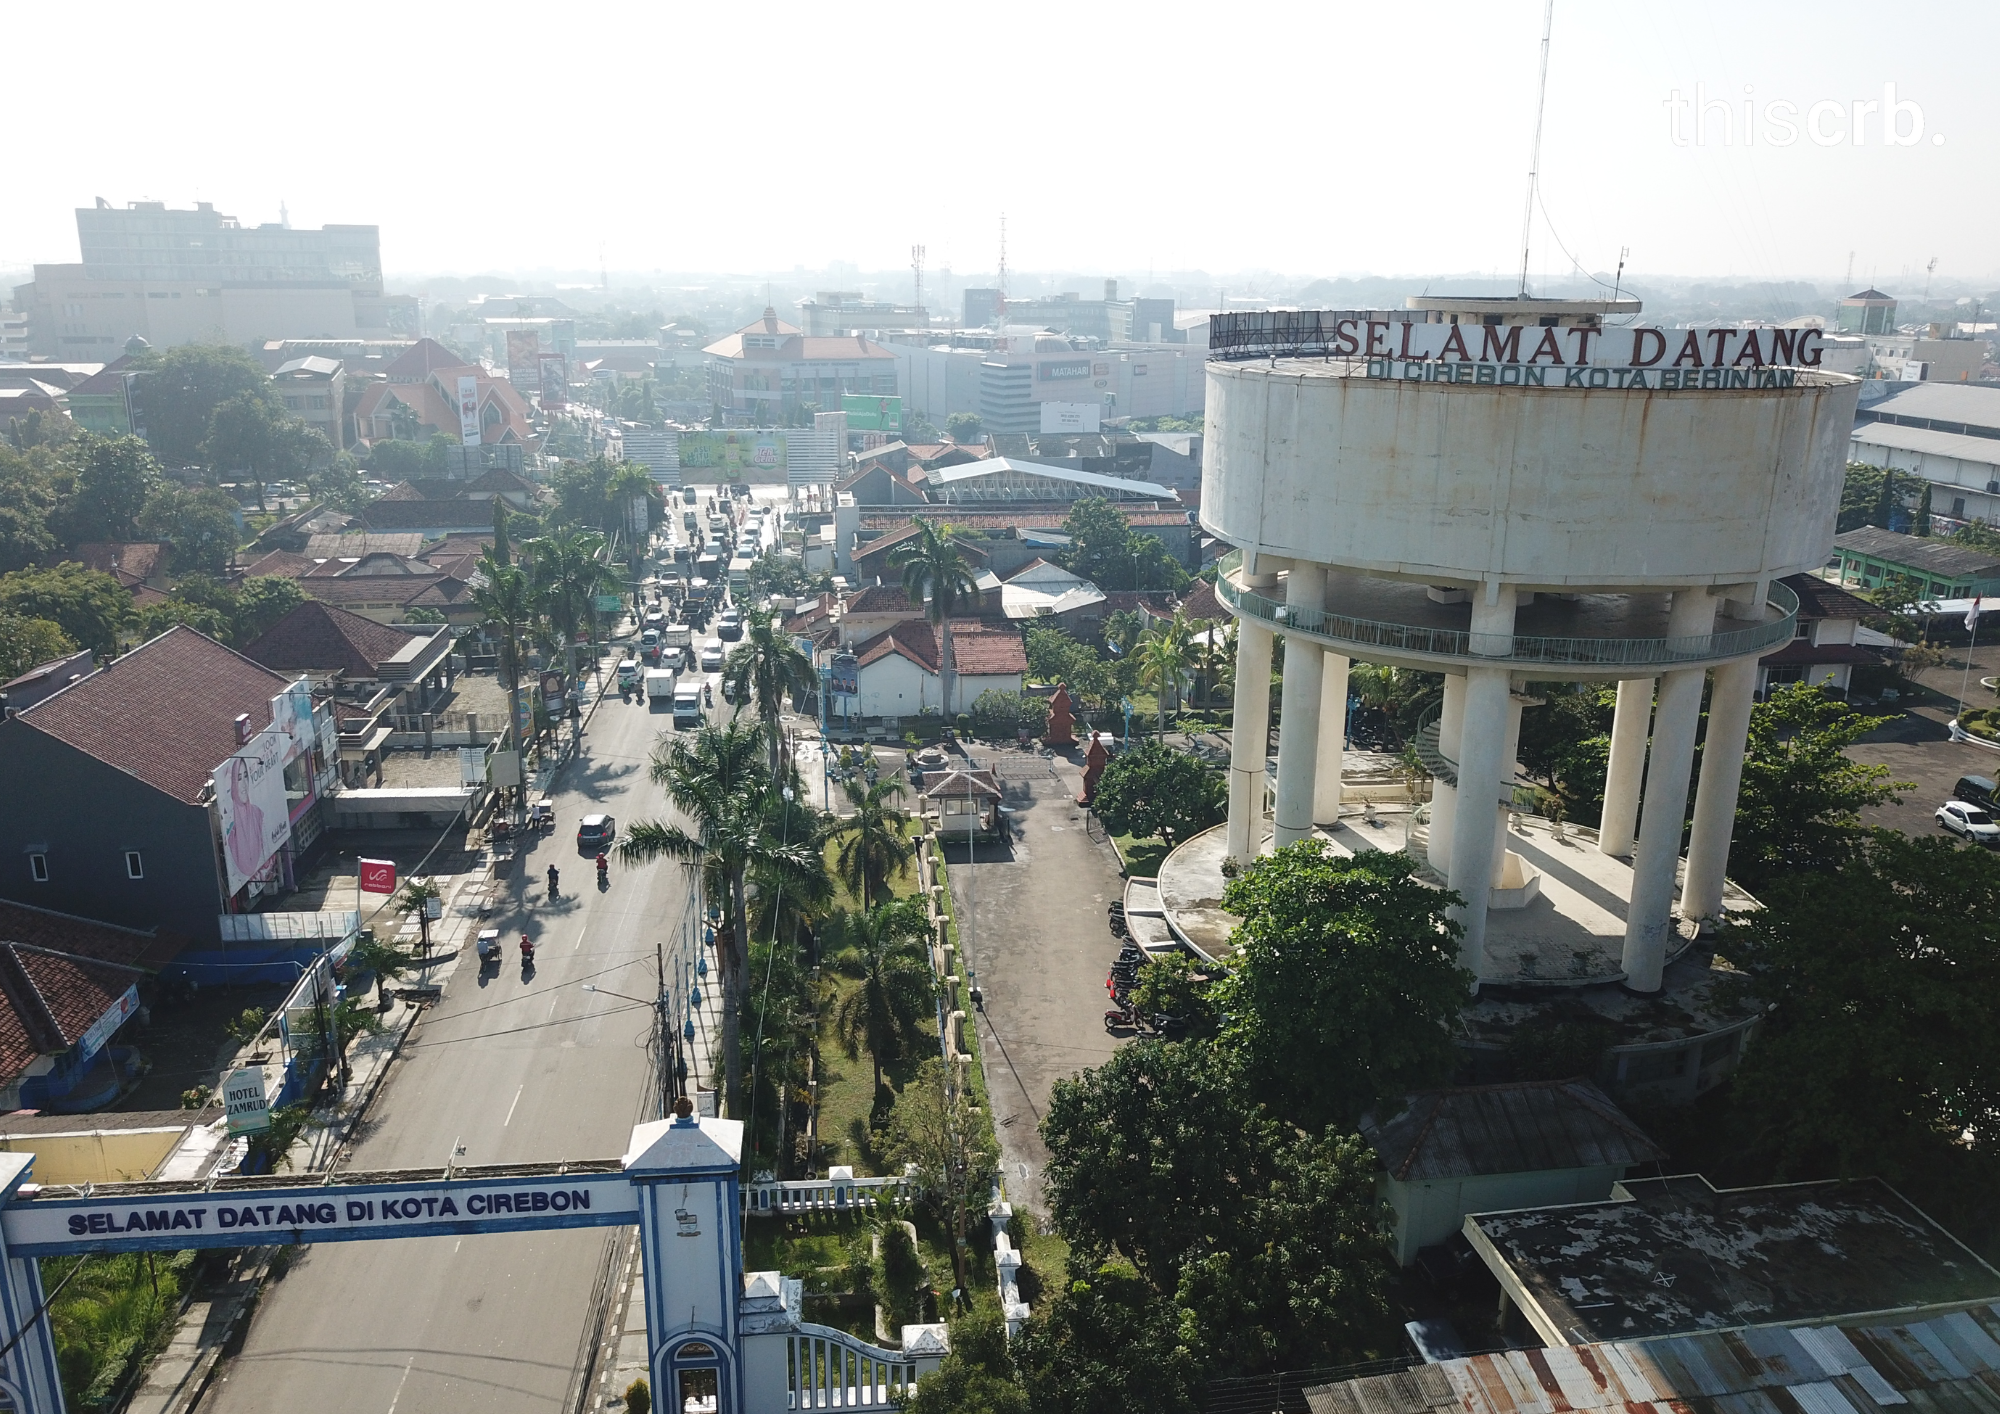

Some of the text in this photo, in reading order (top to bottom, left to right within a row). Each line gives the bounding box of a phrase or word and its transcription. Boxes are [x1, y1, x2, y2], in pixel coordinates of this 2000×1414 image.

[1335, 319, 1824, 367] SELAMAT DATANG
[1052, 366, 1089, 377] MATAHARI
[1366, 360, 1795, 389] DI CIREBON KOTA BERINTAN
[753, 455, 778, 464] Gelas
[757, 446, 774, 456] Teh
[263, 734, 277, 752] LOOK
[250, 751, 279, 784] YOUR HEART
[229, 1086, 260, 1101] HOTEL
[227, 1099, 266, 1115] ZAMRUD
[68, 1189, 591, 1236] SELAMAT DATANG DI KOTA CIREBON
